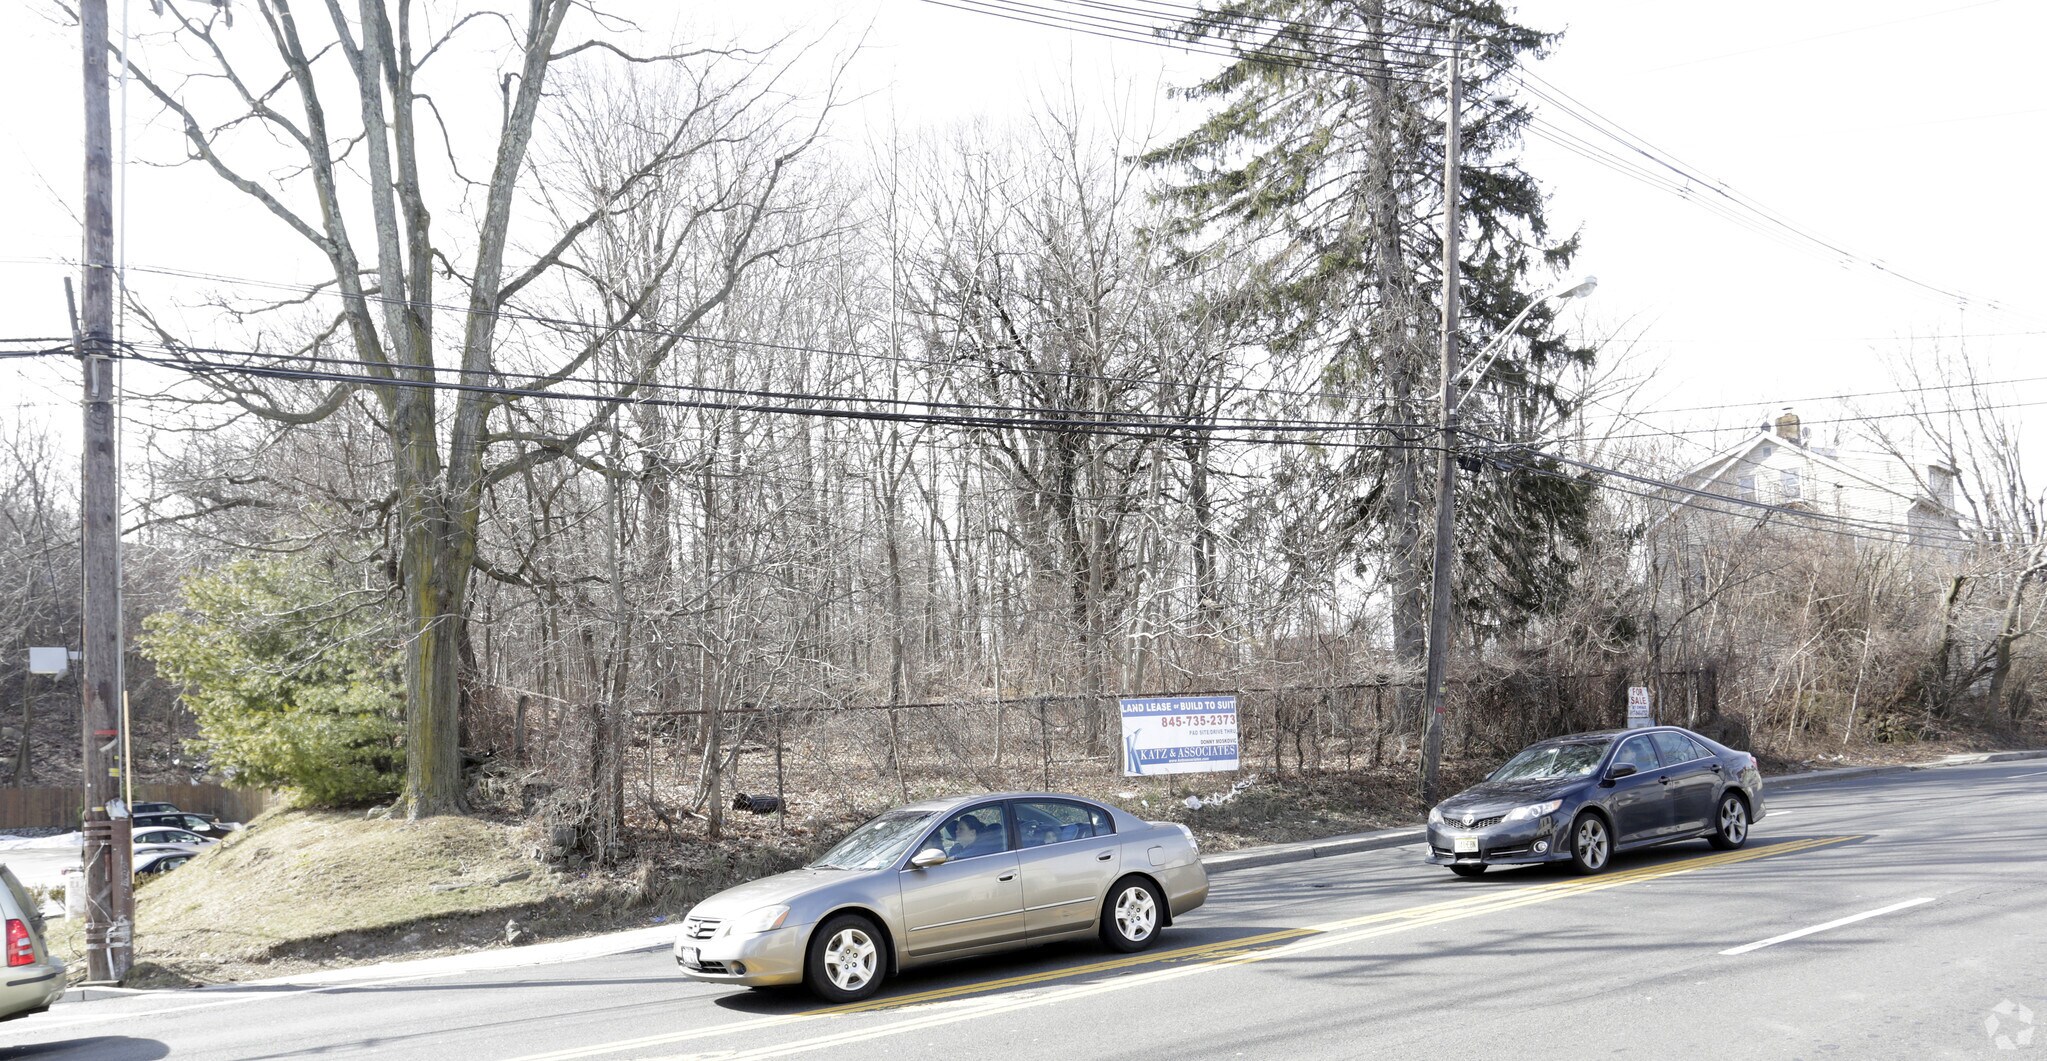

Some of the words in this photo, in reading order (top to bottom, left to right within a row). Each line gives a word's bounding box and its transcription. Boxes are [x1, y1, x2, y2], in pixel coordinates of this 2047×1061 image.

[1632, 688, 1643, 696] FOR
[1121, 703, 1144, 713] LAND
[1146, 702, 1172, 712] LEASE
[1180, 701, 1203, 711] BUILD
[1204, 701, 1216, 710] TO
[1217, 700, 1235, 709] SUIT
[1631, 697, 1647, 705] SALE
[1161, 715, 1236, 727] 845-735-2373
[1141, 749, 1168, 760] KATZ
[1169, 748, 1176, 758] &
[1177, 745, 1236, 758] ASSOCIATES
